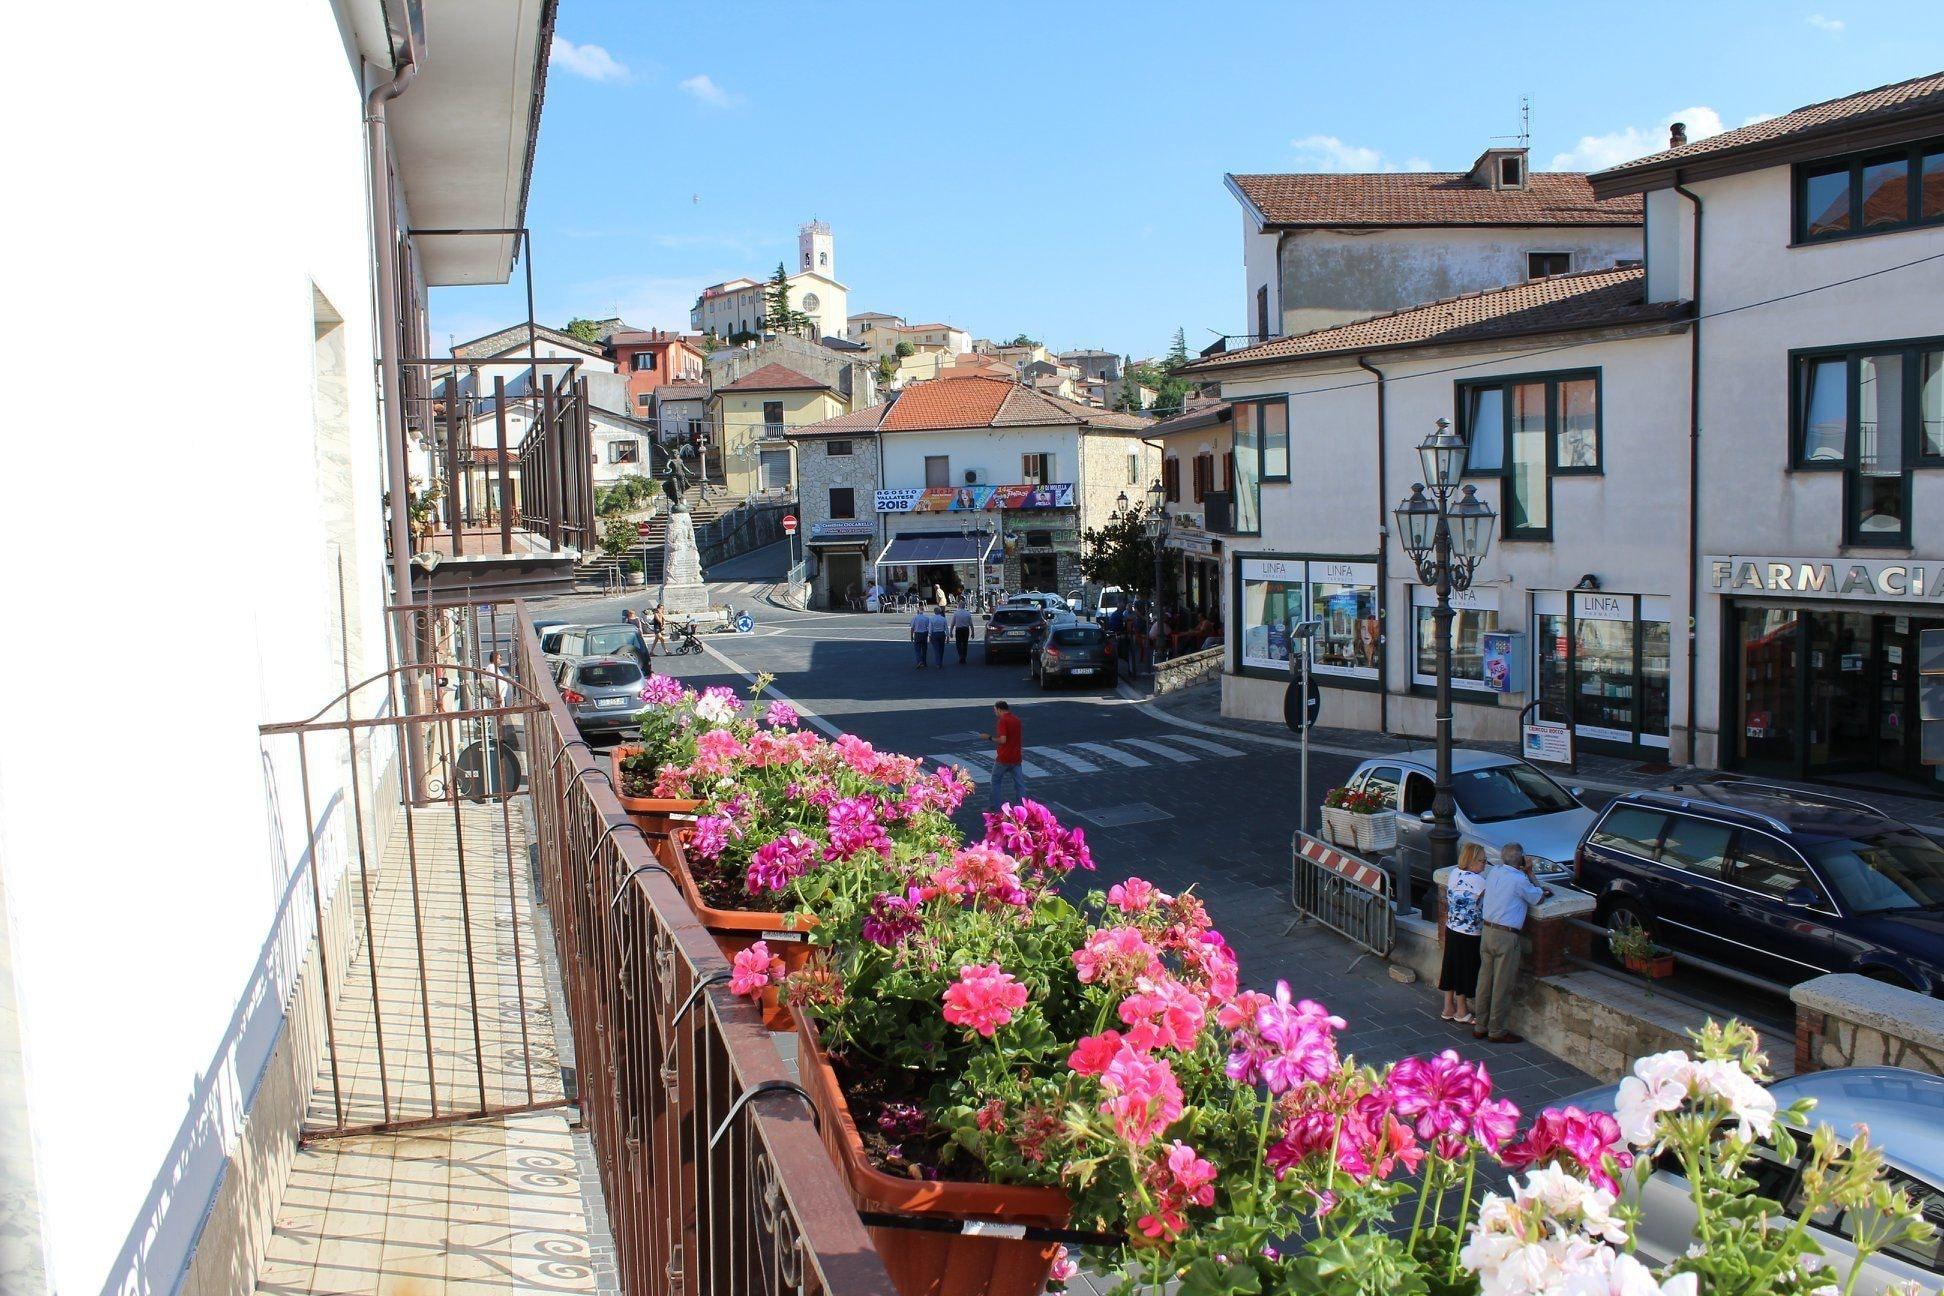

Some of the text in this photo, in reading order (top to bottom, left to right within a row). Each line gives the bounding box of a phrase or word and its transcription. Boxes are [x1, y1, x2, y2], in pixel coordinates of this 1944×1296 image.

[877, 500, 908, 510] 2018
[1262, 562, 1286, 574] LINFA
[1327, 564, 1353, 577] LINFA
[1584, 596, 1620, 611] LINFA
